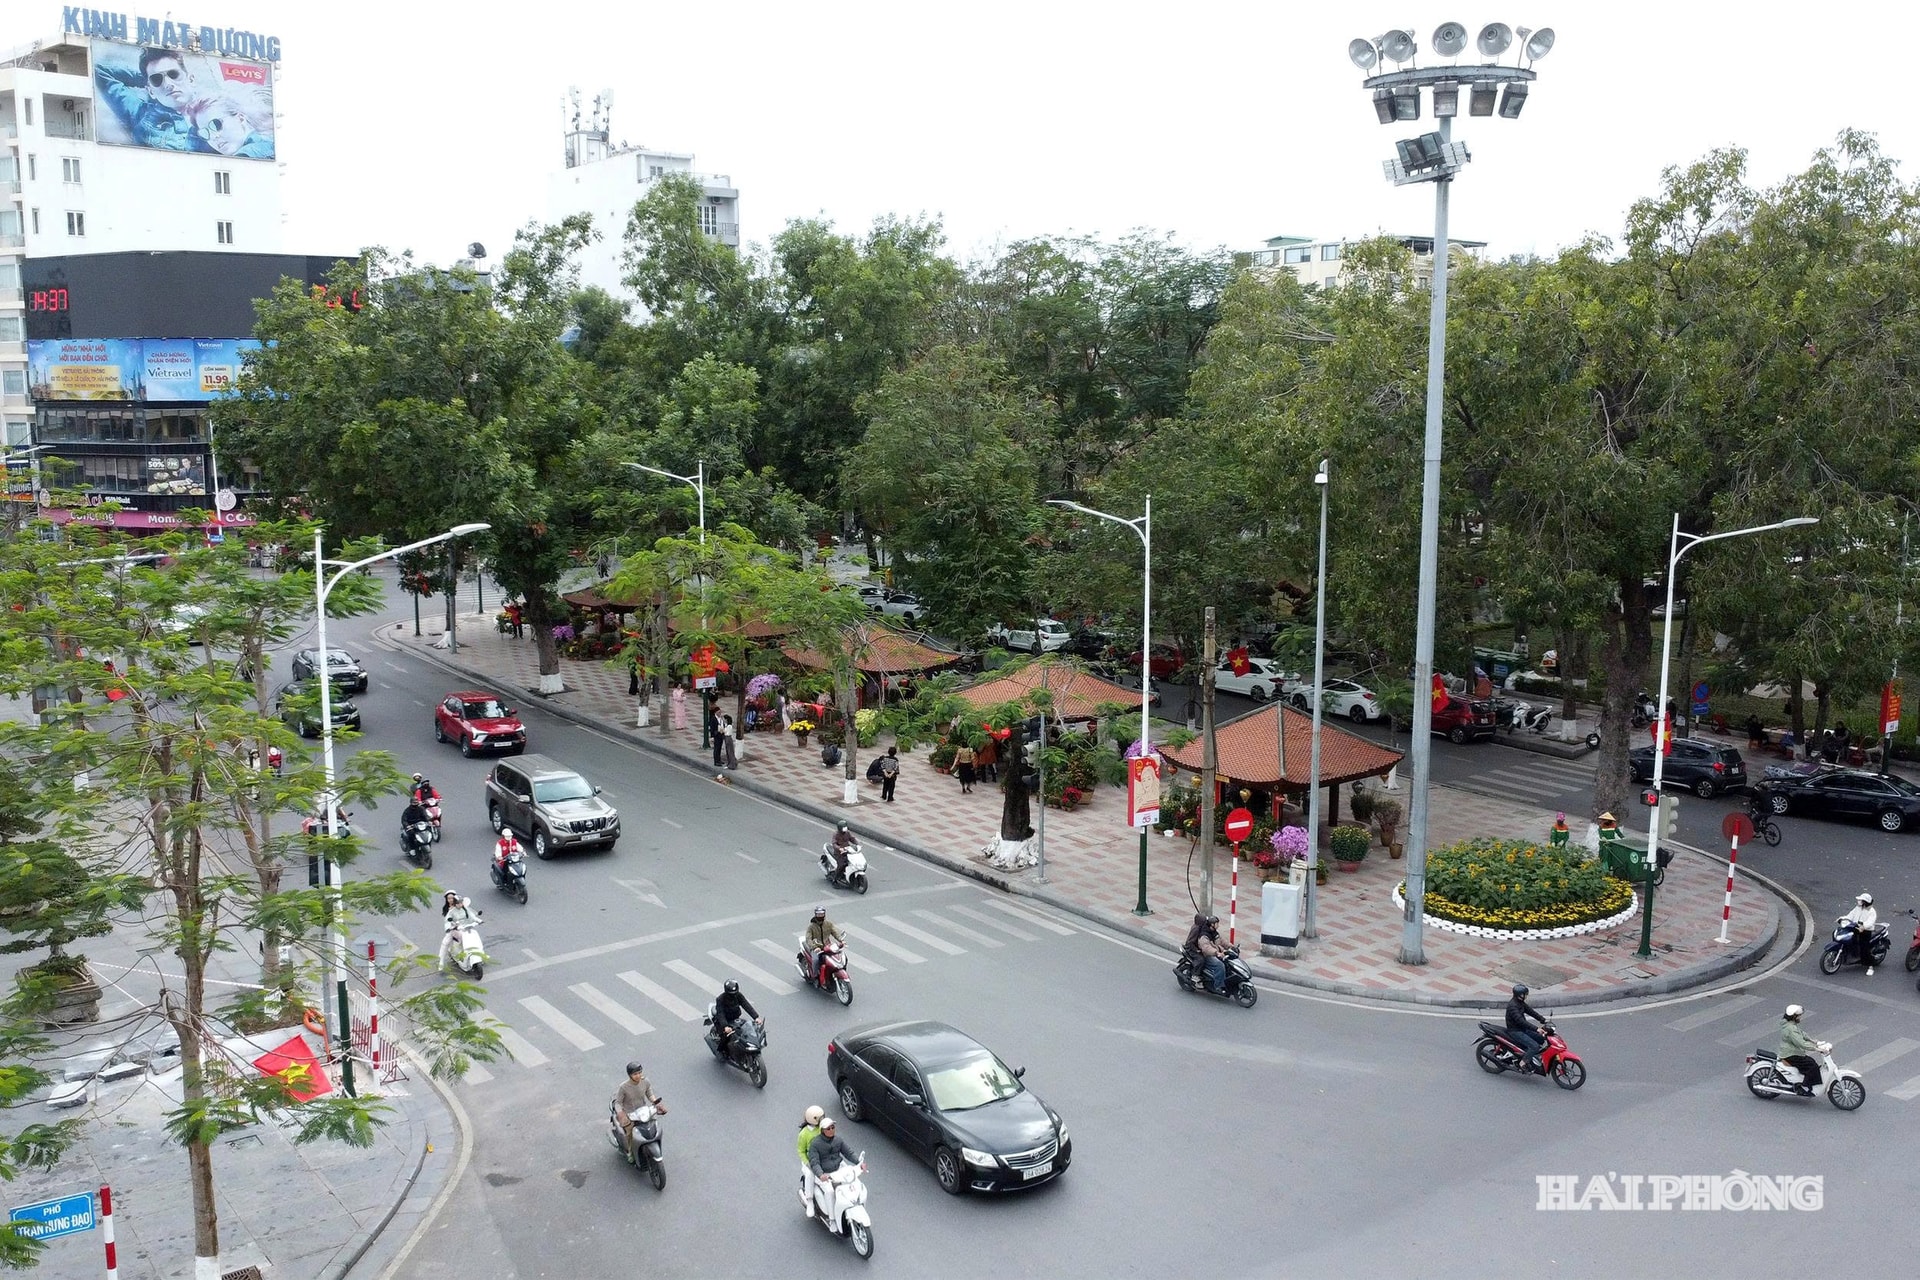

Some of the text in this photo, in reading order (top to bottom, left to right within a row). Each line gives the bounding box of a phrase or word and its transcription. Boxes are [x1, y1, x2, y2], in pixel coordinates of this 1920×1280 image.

[147, 367, 192, 377] Vietravel
[204, 375, 228, 384] 11.99
[43, 1203, 61, 1216] PHỐ
[71, 1212, 90, 1228] ĐẠO
